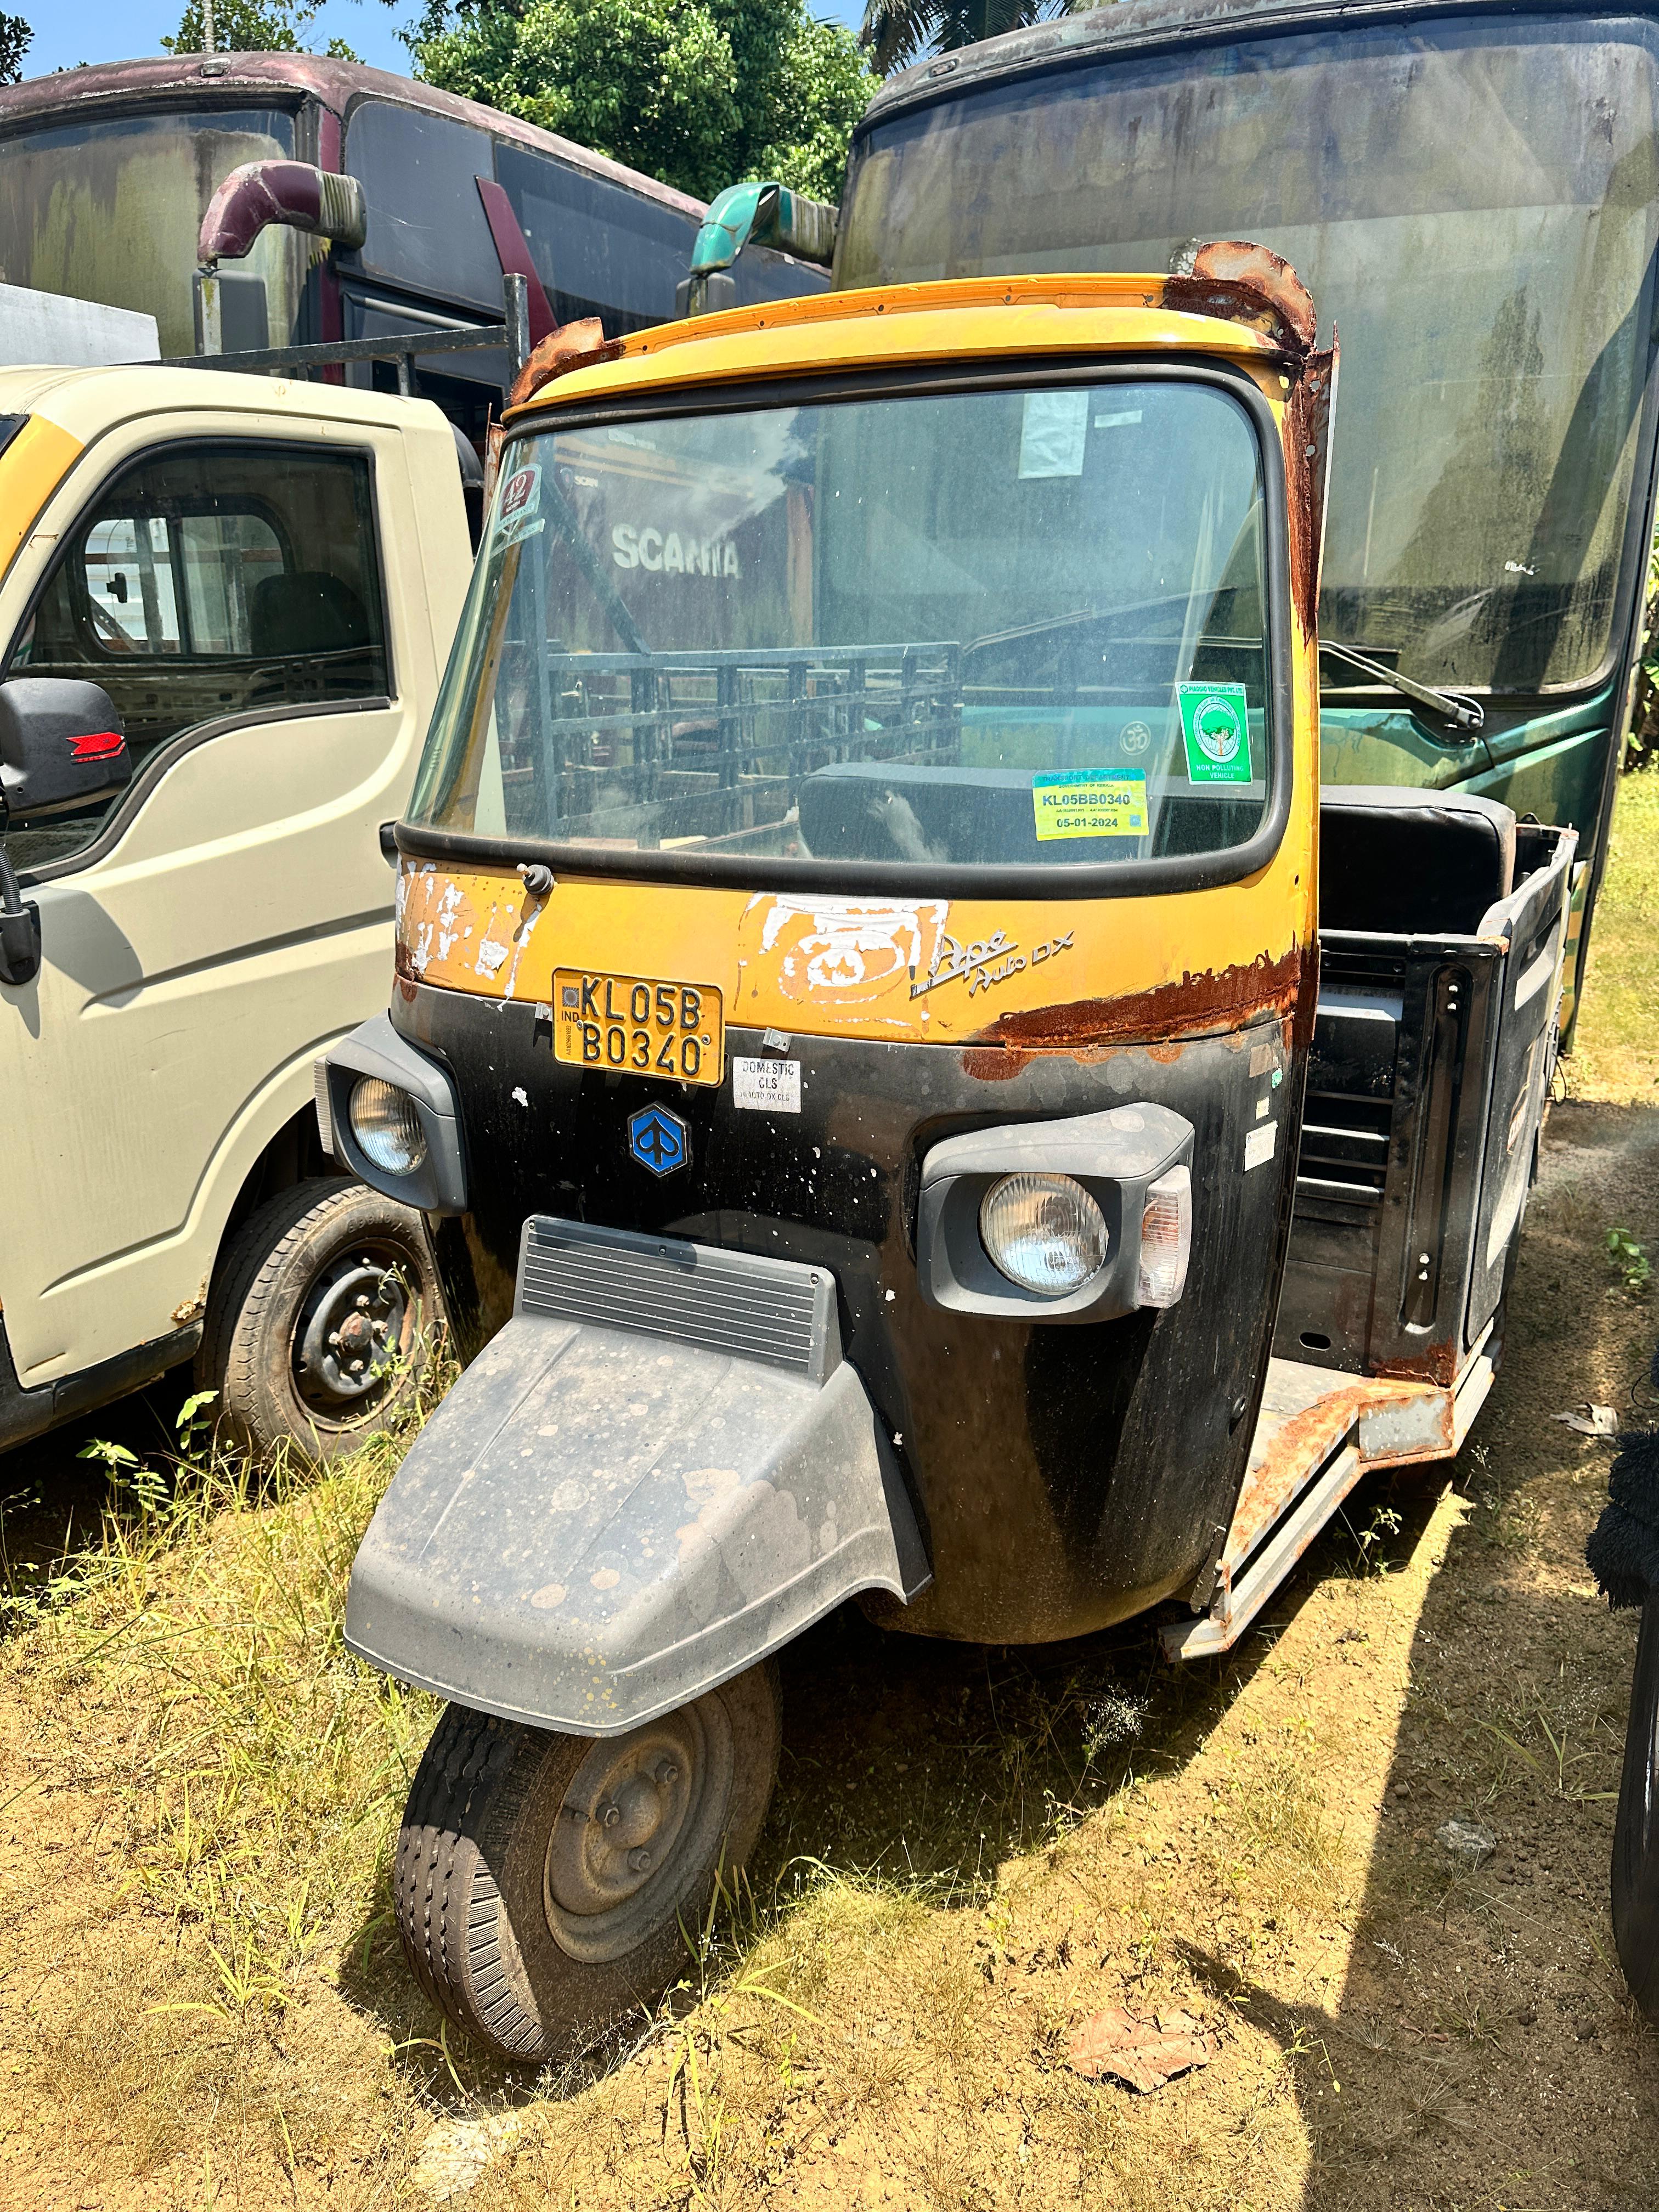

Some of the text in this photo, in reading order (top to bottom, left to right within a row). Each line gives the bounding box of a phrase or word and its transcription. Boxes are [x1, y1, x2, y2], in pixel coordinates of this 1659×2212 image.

[504, 474, 527, 506] 42
[612, 523, 743, 579] SCANIA
[1043, 794, 1130, 806] KL05BB0340
[1057, 818, 1118, 827] 05-01-2024
[926, 928, 1010, 980] Ape
[969, 929, 1075, 997] Auto DX
[561, 1010, 579, 1023] IND
[581, 975, 701, 1030] KL05B
[583, 1022, 701, 1076] B0340
[742, 1061, 794, 1075] DOMESTIC
[759, 1077, 777, 1089] CLS
